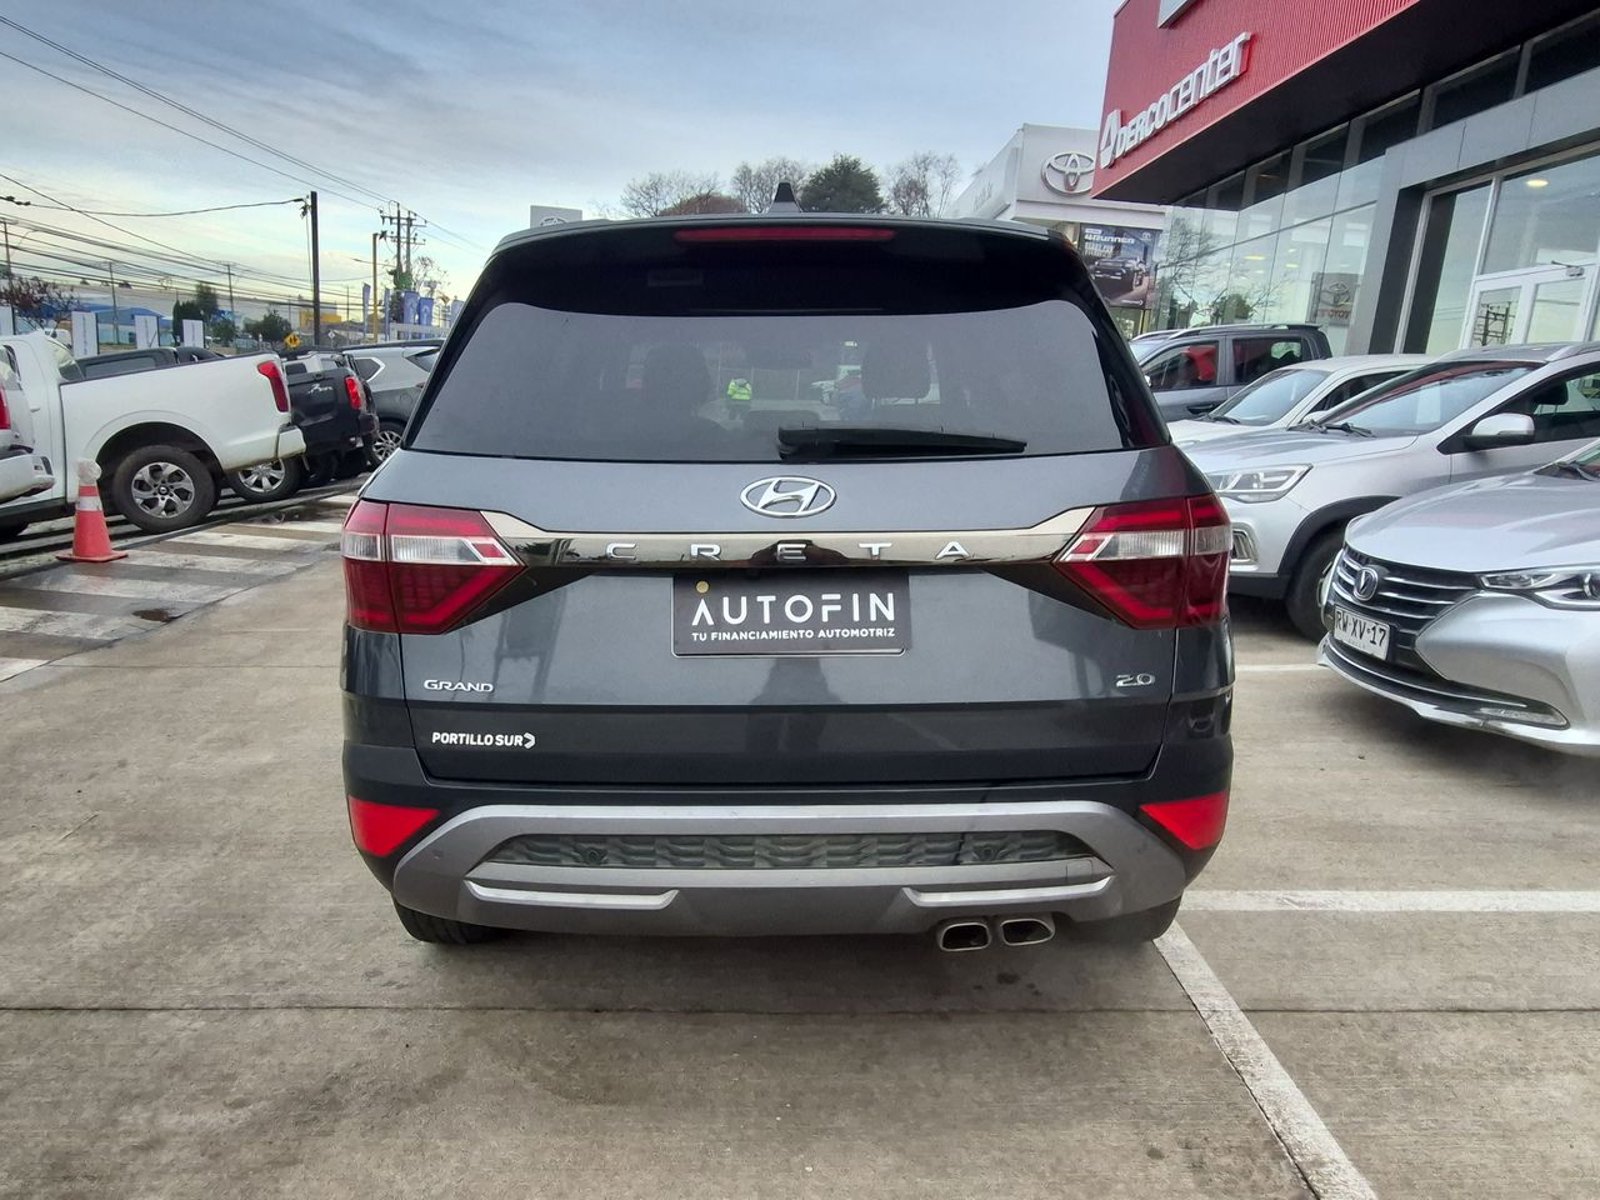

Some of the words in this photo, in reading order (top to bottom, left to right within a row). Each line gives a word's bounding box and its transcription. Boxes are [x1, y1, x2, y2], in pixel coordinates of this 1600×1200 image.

[605, 541, 972, 561] CRETA
[691, 592, 896, 626] AUTOFIN
[692, 632, 707, 641] TU
[711, 629, 814, 641] FINANCIAMIENTO
[817, 627, 896, 639] AUTOMOTRIZ
[423, 679, 494, 693] GRAND
[431, 731, 494, 746] PORTILLO
[495, 734, 523, 747] SUR
